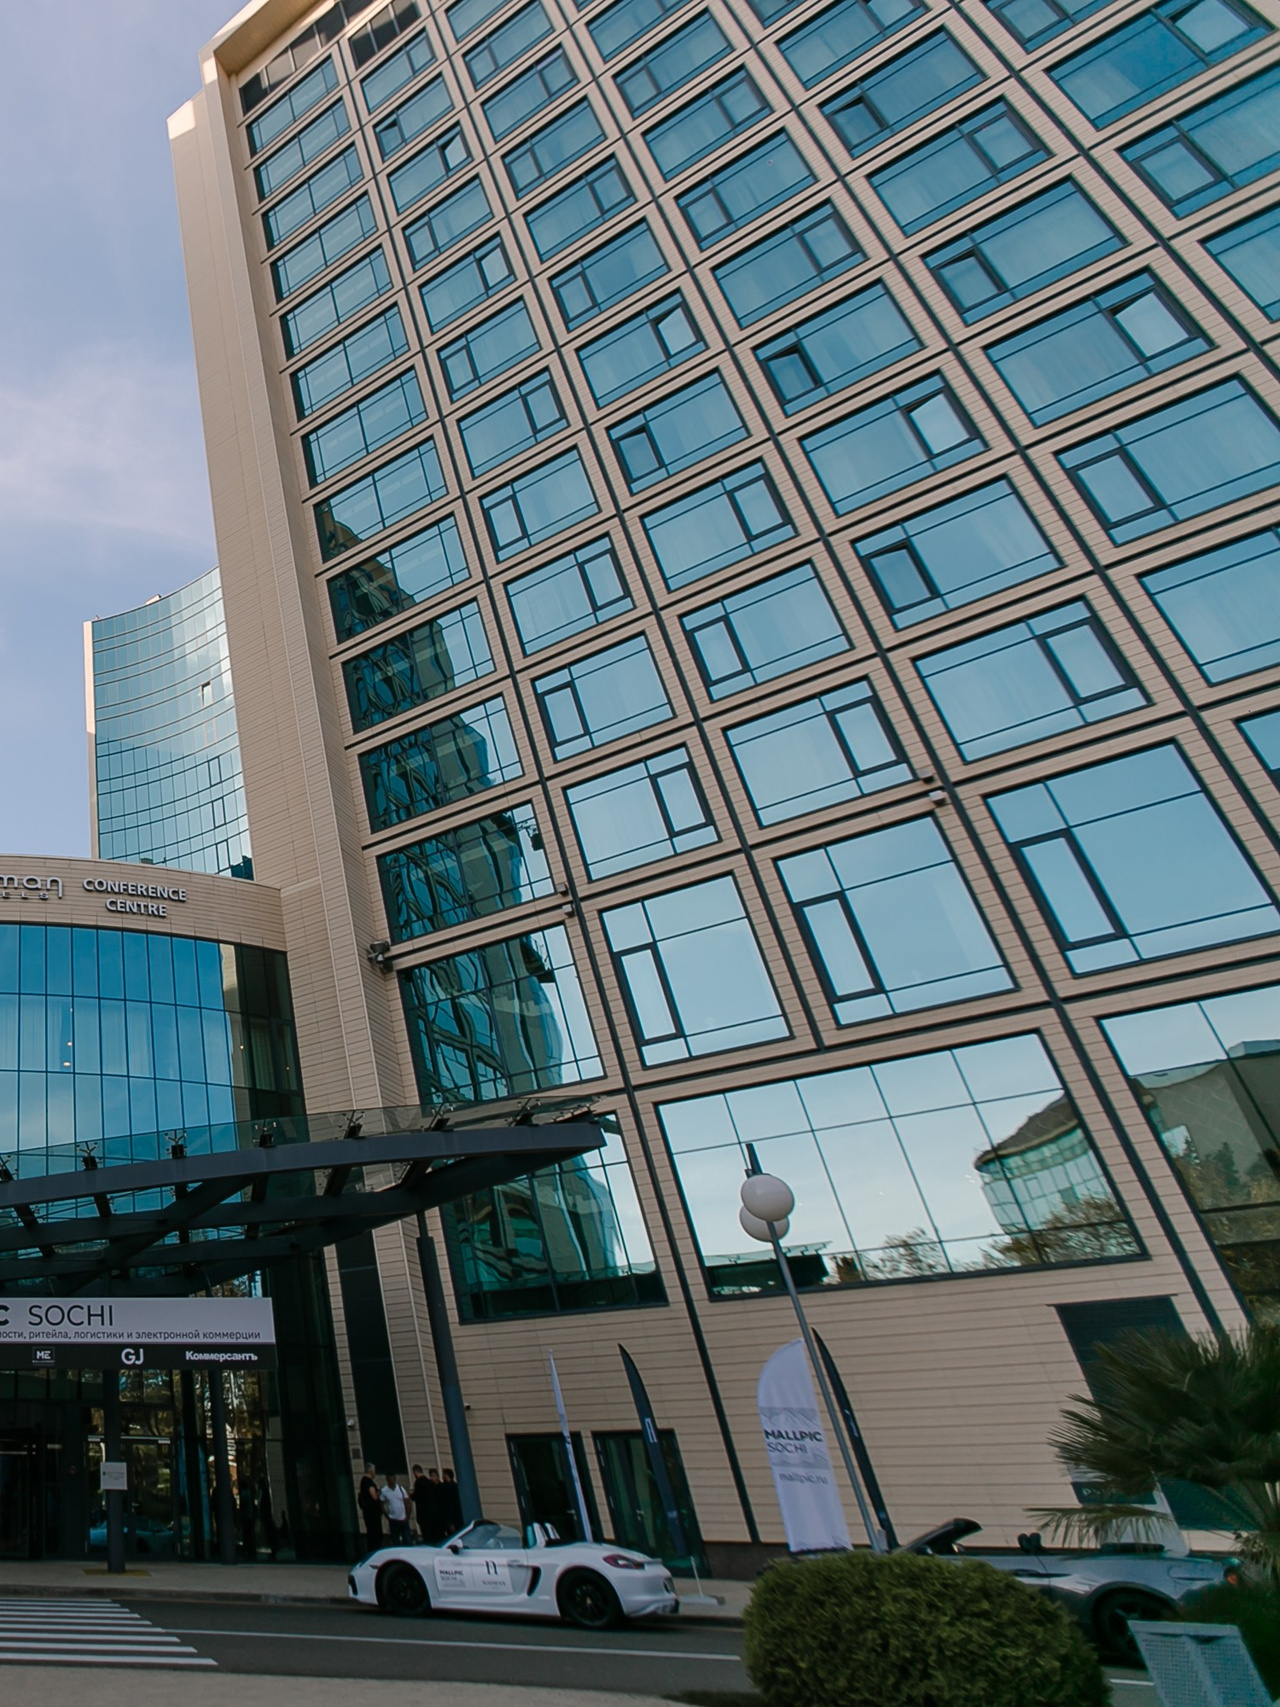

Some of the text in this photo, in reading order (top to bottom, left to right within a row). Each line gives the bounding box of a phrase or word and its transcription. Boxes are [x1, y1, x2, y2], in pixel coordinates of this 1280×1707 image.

[82, 877, 187, 902] CONFERENCE
[105, 898, 168, 917] CENTRE
[28, 1304, 114, 1326] SOCHI
[28, 1329, 71, 1340] ритейла,
[73, 1330, 124, 1339] логистики
[127, 1330, 133, 1339] и
[136, 1329, 200, 1340] электронной
[203, 1330, 260, 1340] коммерции
[121, 1348, 144, 1365] GJ
[185, 1350, 258, 1362] Коммерсантъ
[764, 1429, 823, 1442] MALLPIC
[767, 1442, 808, 1454] SOCHI
